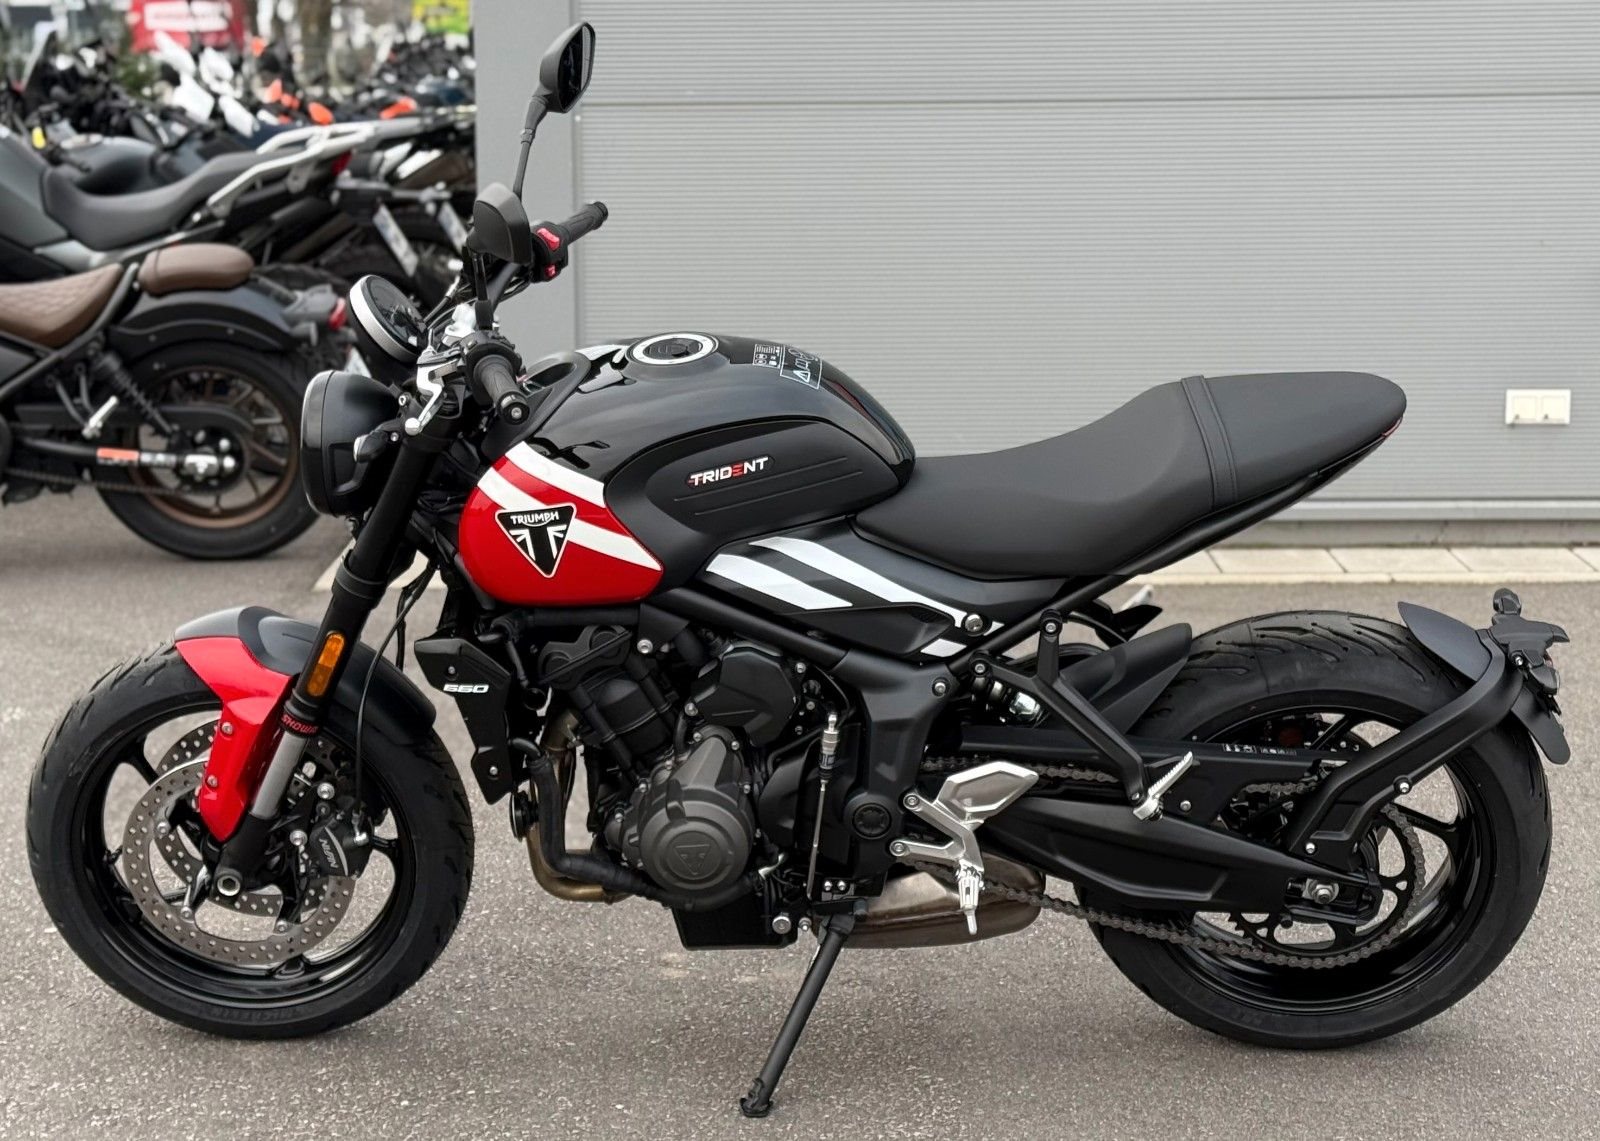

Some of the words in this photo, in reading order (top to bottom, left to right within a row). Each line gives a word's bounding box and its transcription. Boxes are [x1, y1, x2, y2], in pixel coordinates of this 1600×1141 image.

[690, 456, 769, 486] TRIDENT
[510, 511, 560, 527] TRIUMPH
[443, 684, 489, 694] 660
